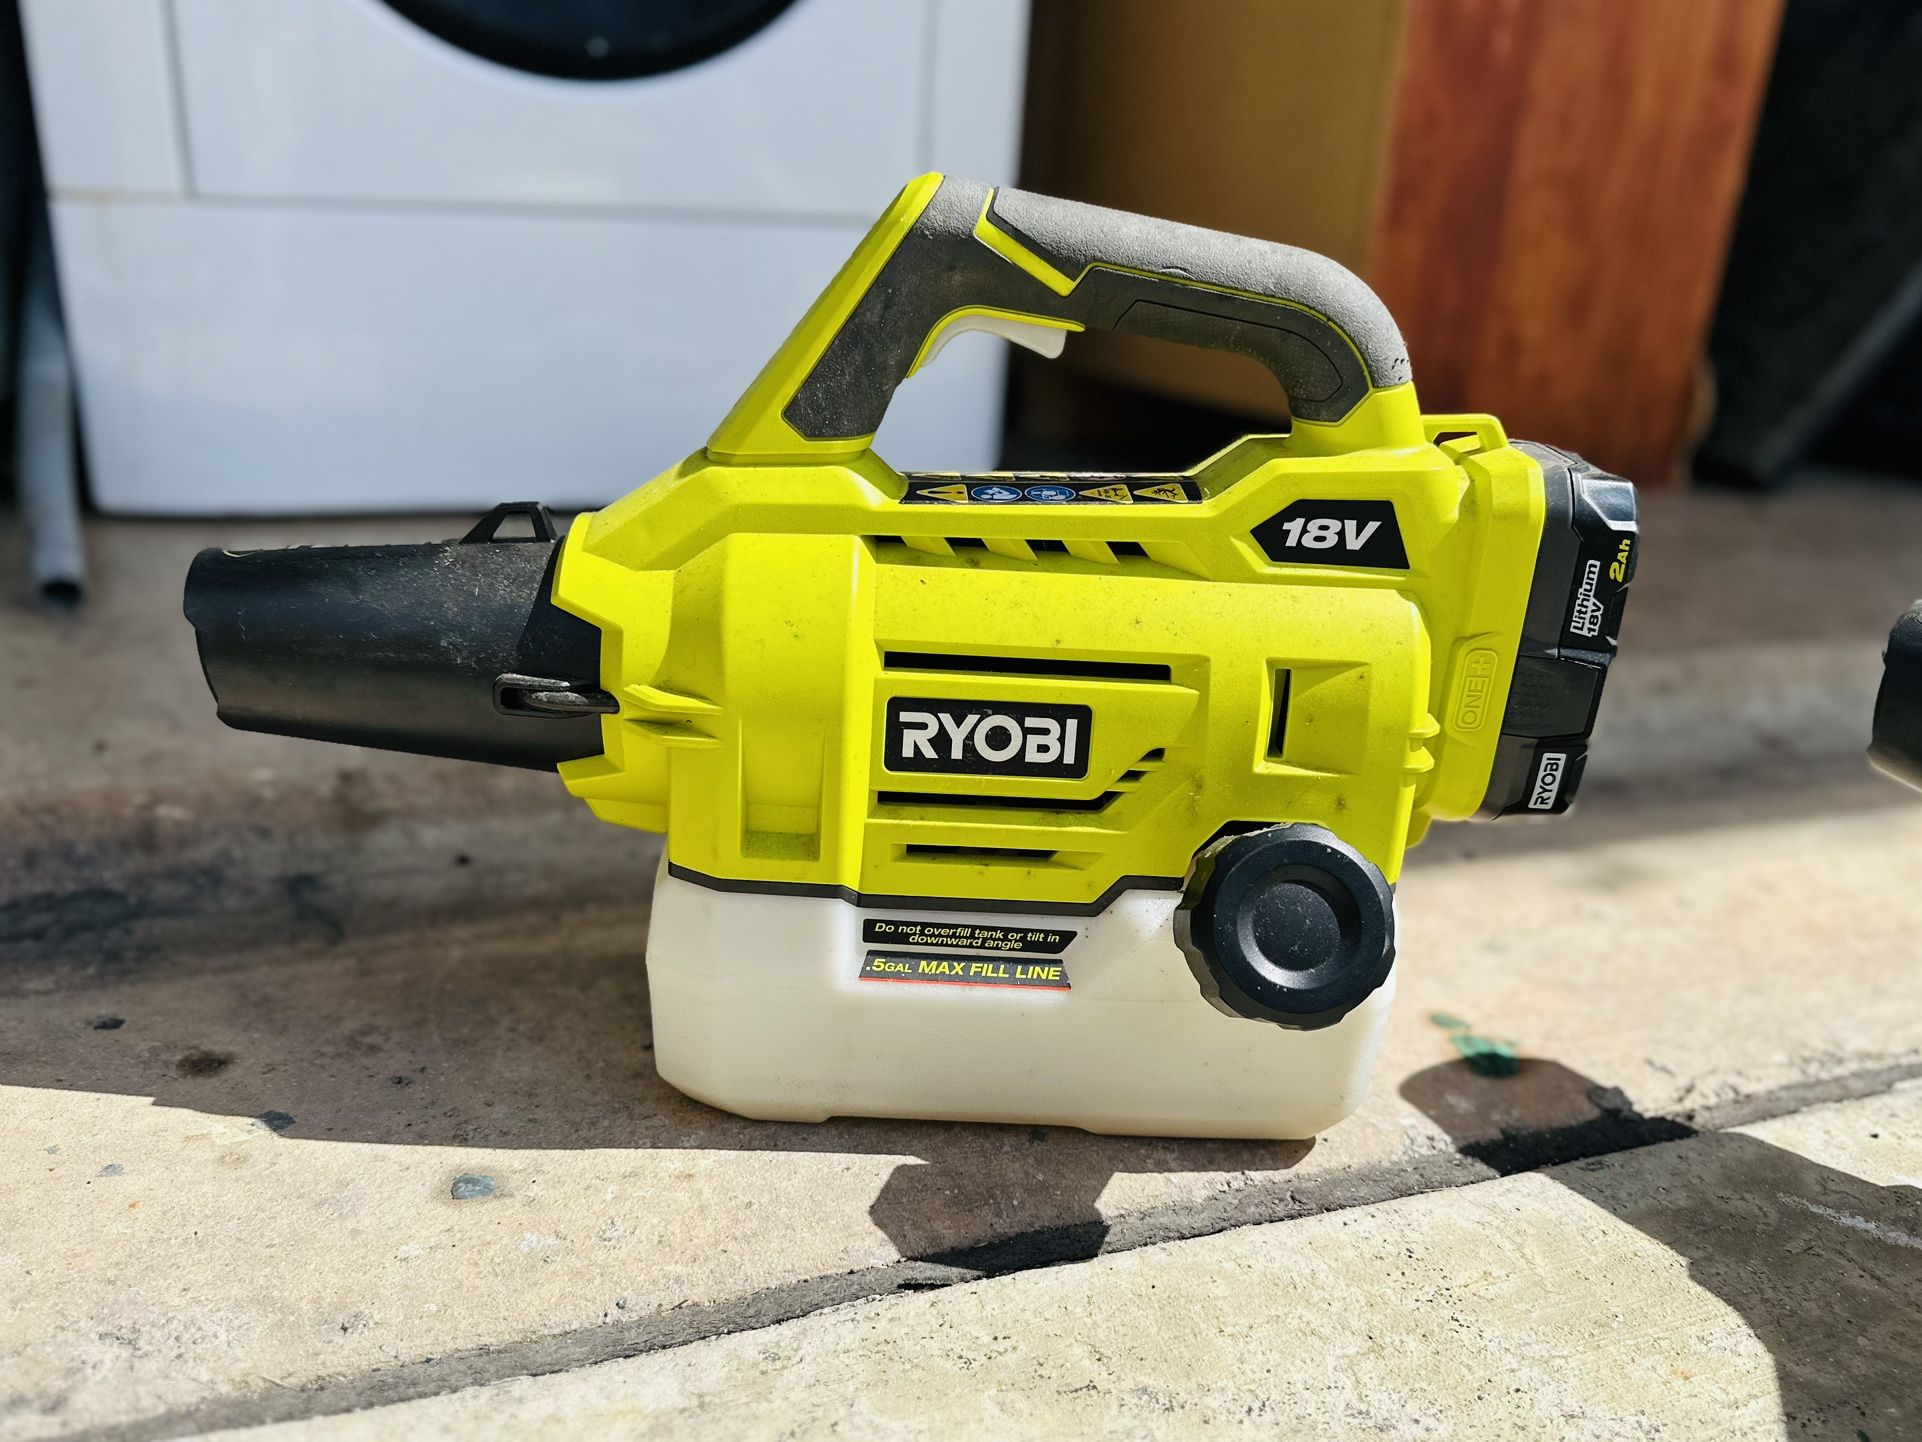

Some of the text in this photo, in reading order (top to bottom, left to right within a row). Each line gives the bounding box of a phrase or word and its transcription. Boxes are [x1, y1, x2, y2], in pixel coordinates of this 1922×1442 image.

[1281, 517, 1382, 551] 18V
[1609, 539, 1631, 583] 2Ah
[1572, 562, 1598, 633] Lithium
[1587, 601, 1603, 635] 18V
[899, 711, 1078, 765] RYOBI
[1533, 756, 1562, 806] RYOBI
[875, 923, 1060, 943] Do not overfill tank or tilt in
[909, 934, 1023, 950] downward angle
[865, 958, 1062, 980] .5GAL MAX FILL LINE
